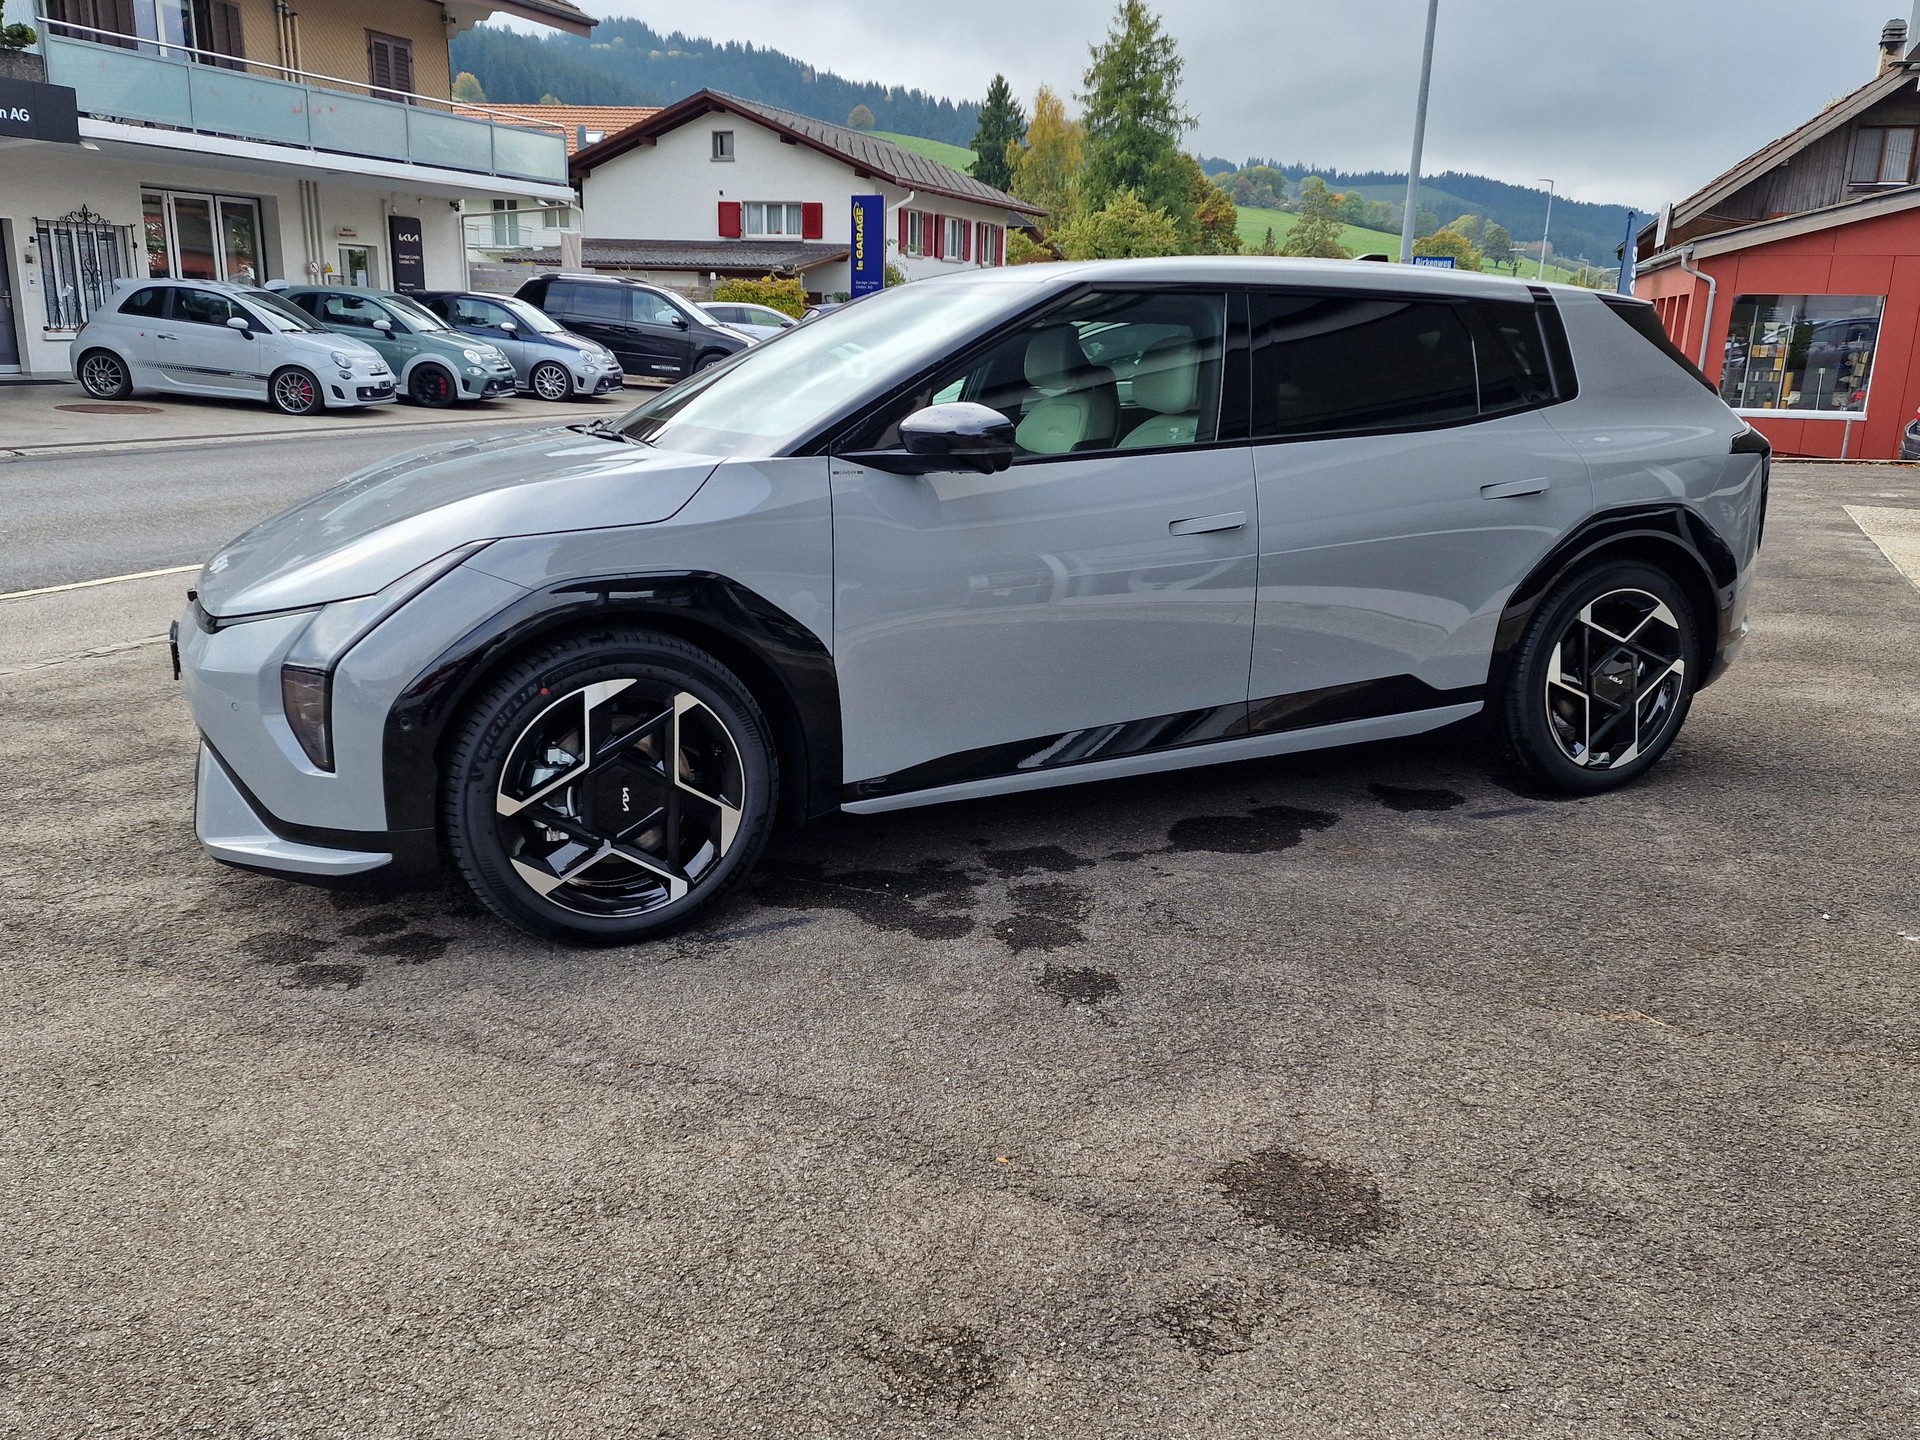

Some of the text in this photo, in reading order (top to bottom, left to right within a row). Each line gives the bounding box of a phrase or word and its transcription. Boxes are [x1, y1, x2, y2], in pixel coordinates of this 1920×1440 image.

[10, 107, 30, 122] AG
[398, 233, 420, 242] KIA
[856, 207, 864, 271] le GARAGE
[1415, 257, 1452, 269] Birkenweg
[478, 682, 538, 761] MICHELIN
